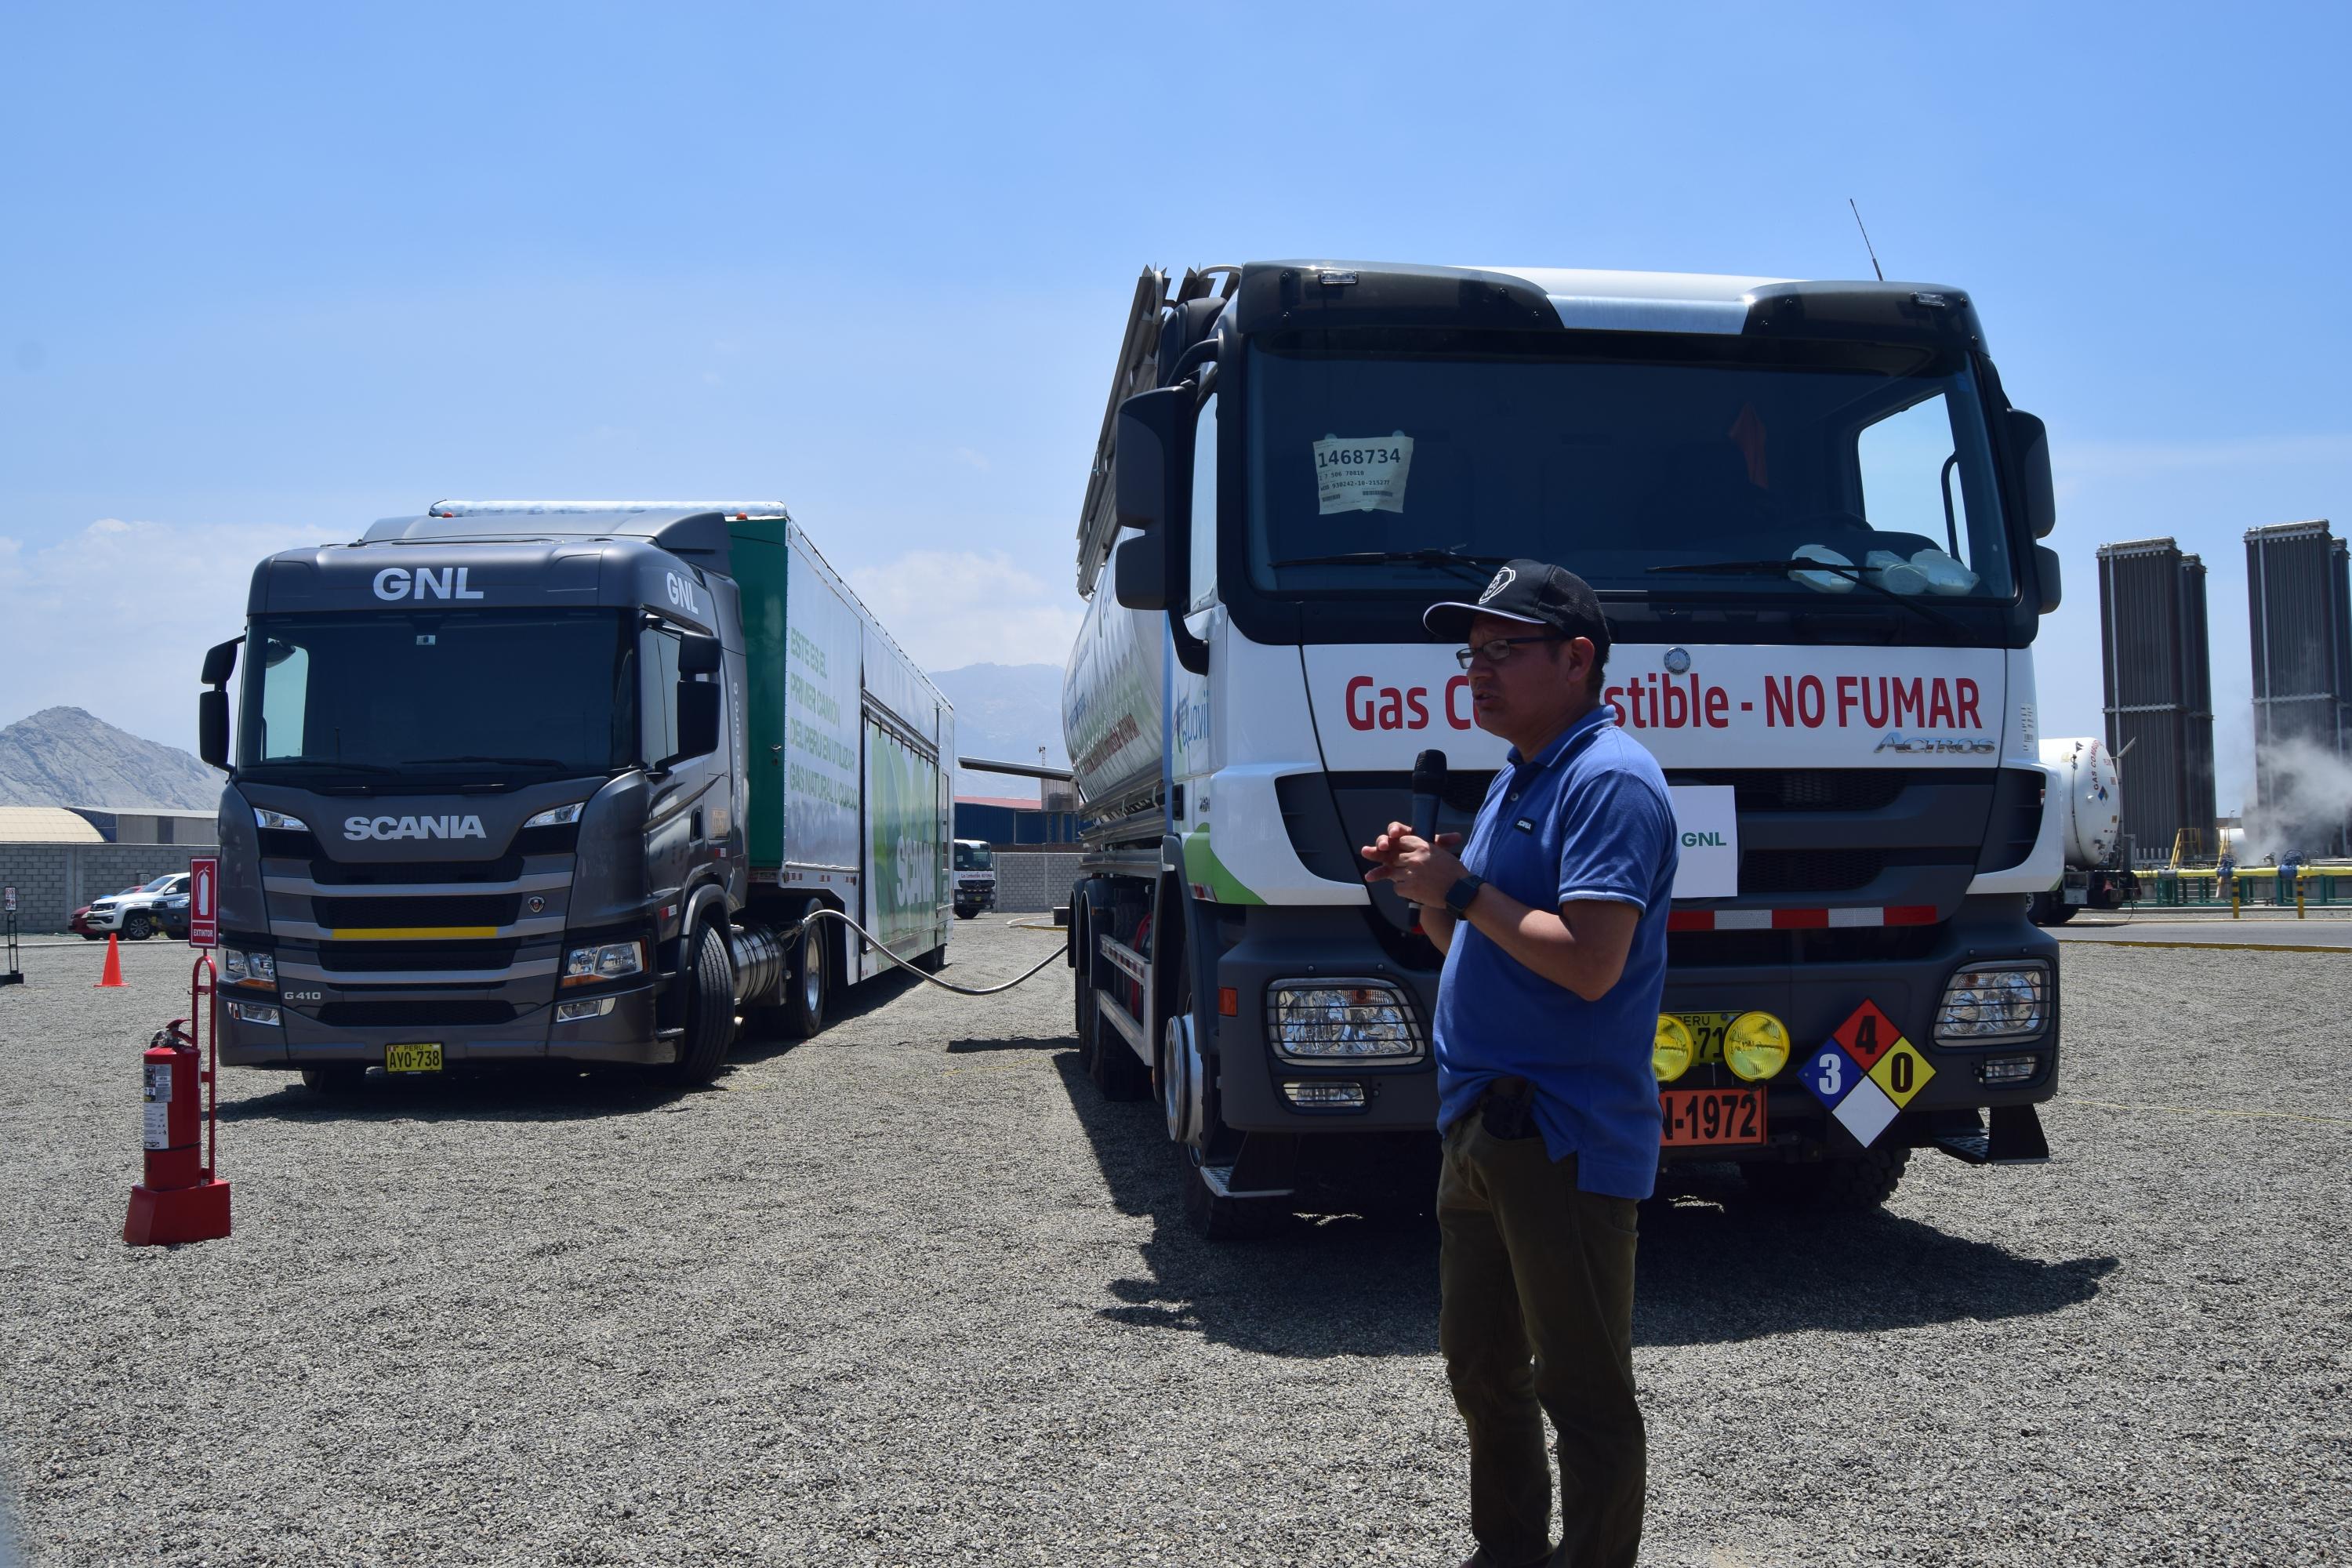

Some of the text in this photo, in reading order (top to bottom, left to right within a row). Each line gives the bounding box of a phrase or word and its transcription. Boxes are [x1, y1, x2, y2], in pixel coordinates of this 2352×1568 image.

[1318, 448, 1400, 468] 1468734
[373, 568, 484, 601] GNL
[667, 572, 699, 615] GNL
[790, 626, 810, 667] ESTE
[1345, 675, 1429, 731] Gas
[1444, 673, 1729, 730] Cstible
[1764, 675, 1825, 728] NO
[1836, 676, 1983, 728] FUMAR
[789, 762, 804, 793] GAS
[343, 815, 487, 840] SCANIA
[1681, 832, 1726, 848] GNL
[193, 928, 213, 937] EXTINTOR
[1855, 1015, 1878, 1054] 4
[1818, 1051, 1914, 1094] 3 0
